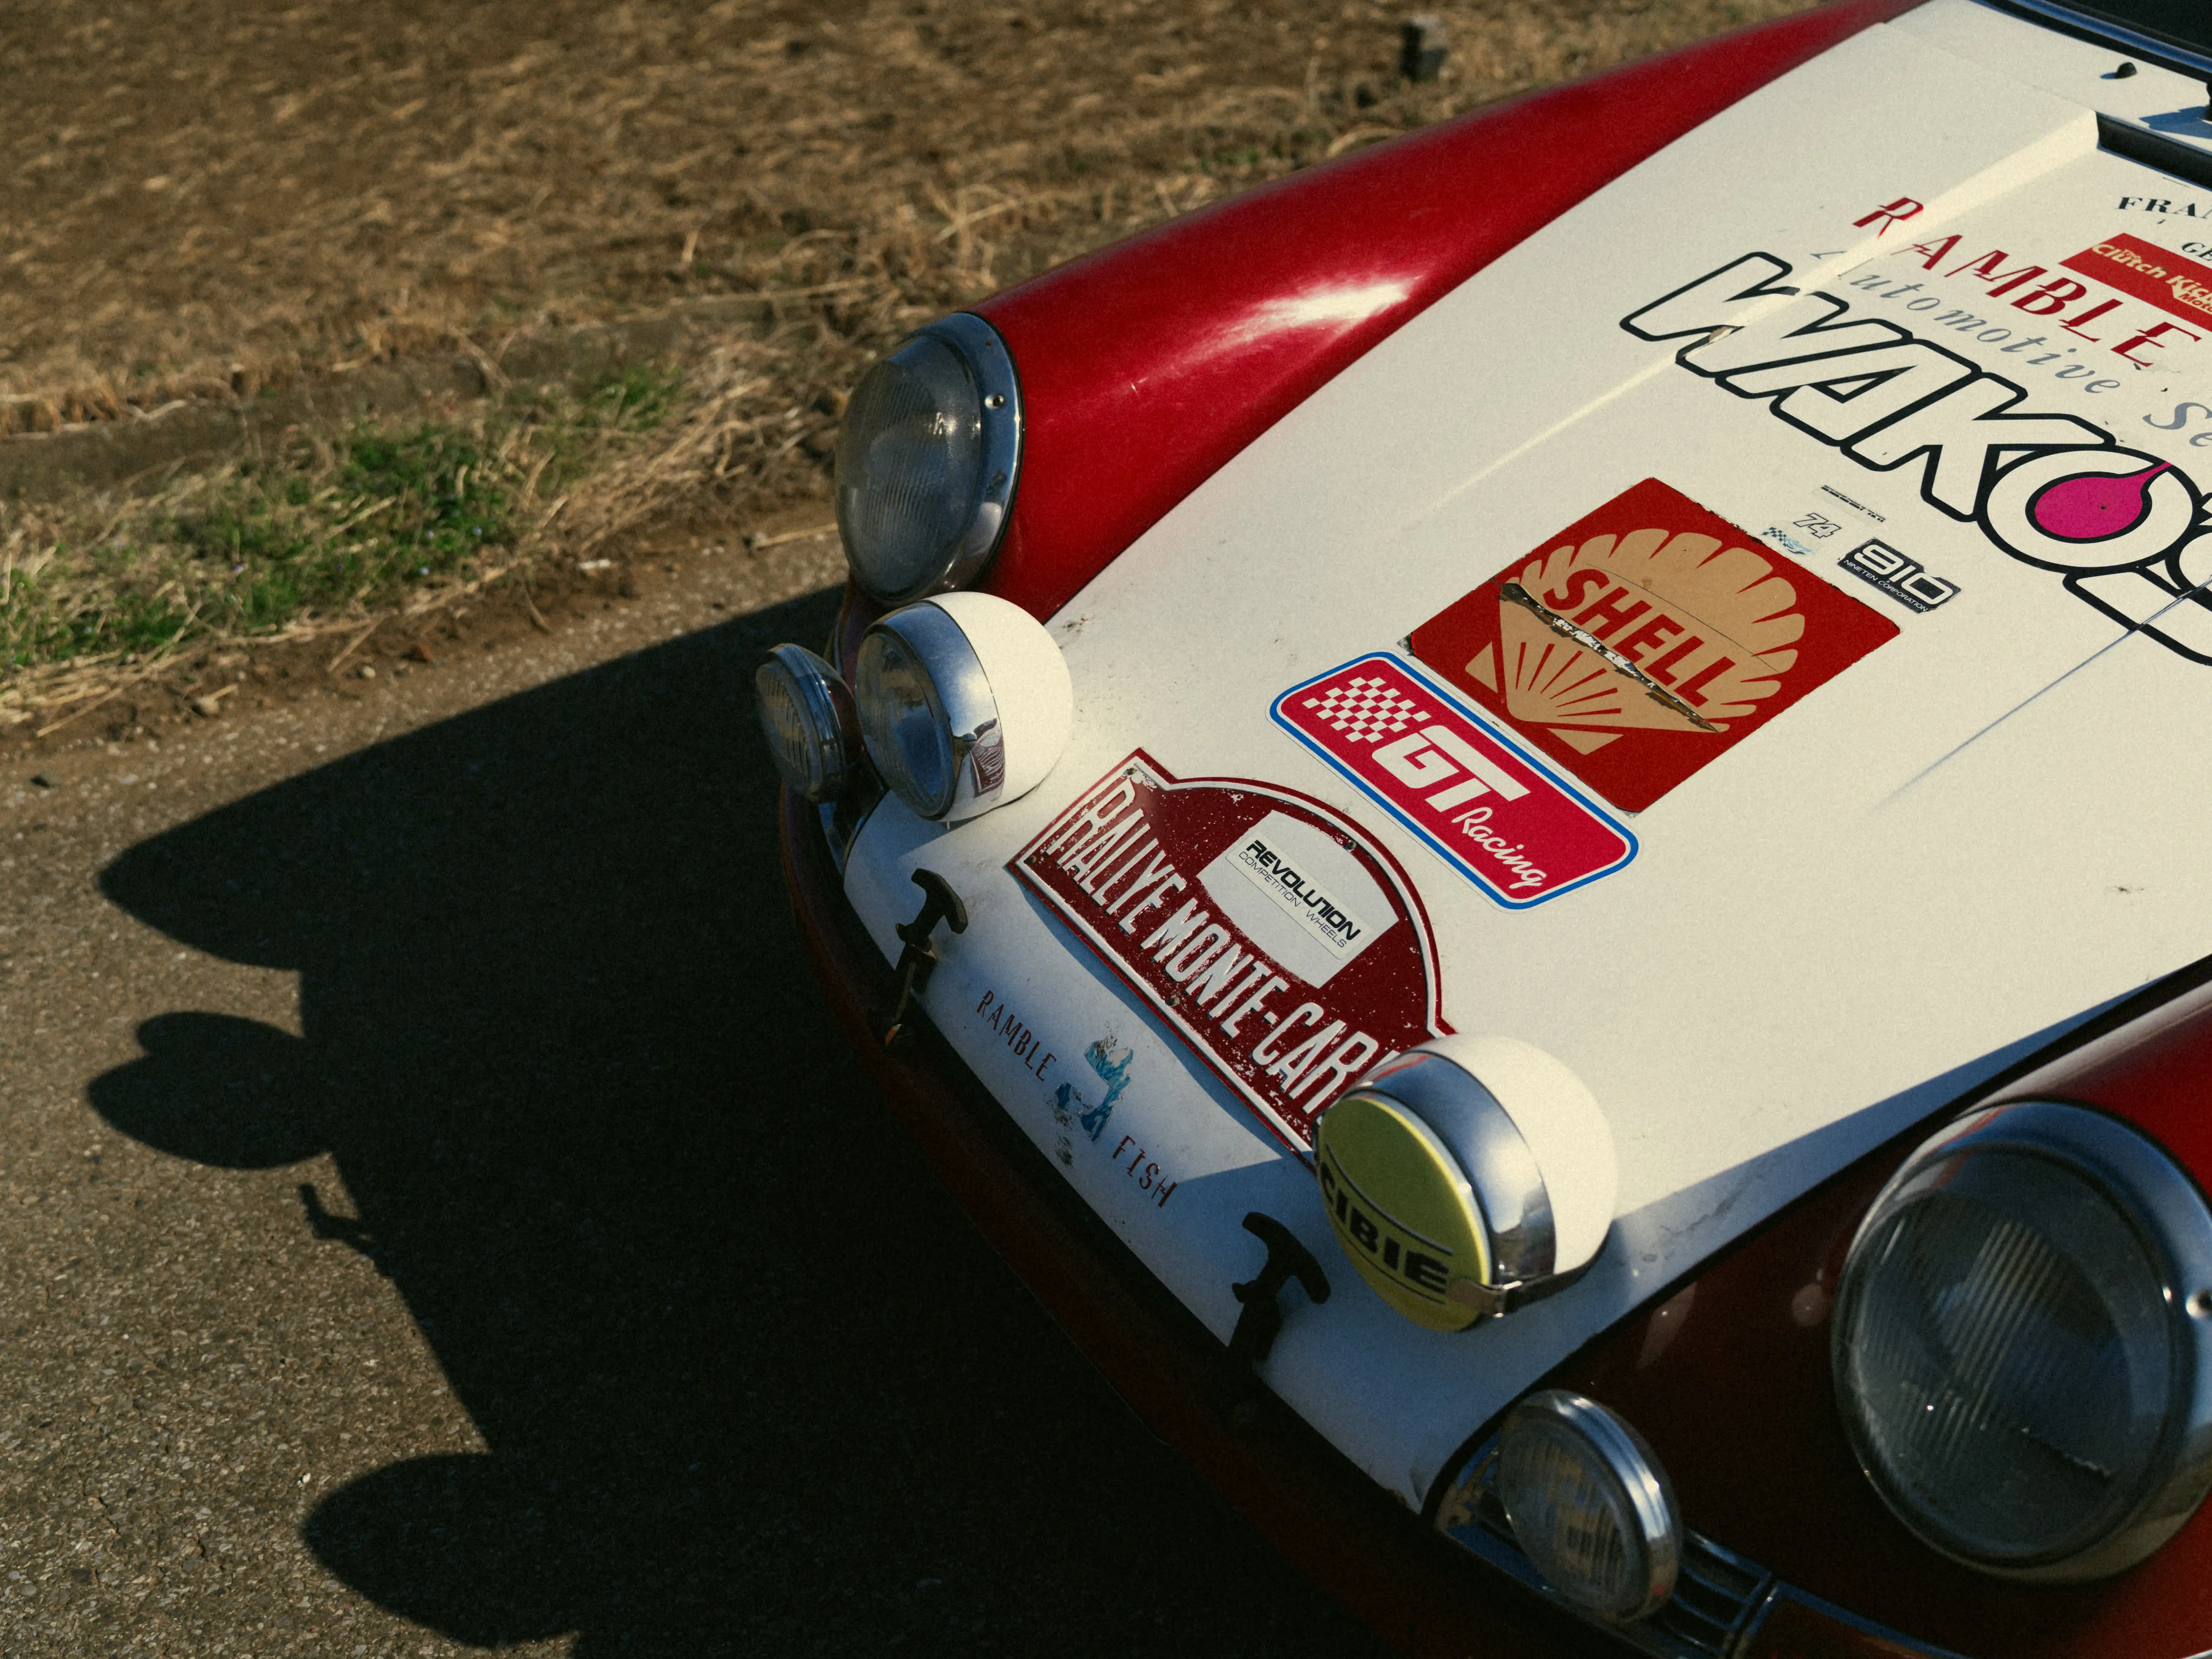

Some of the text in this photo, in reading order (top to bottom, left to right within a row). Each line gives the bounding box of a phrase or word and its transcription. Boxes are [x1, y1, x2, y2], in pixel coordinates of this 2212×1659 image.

[1853, 197, 2202, 367] RAMBLE
[2092, 244, 2167, 279] Clutch
[1792, 512, 1842, 539] 74
[1843, 559, 1929, 612] NINETEN CORPORATION
[1544, 568, 1742, 709] SHELL
[1372, 725, 1531, 812] GT
[1043, 778, 1187, 936] RALLYE
[1246, 839, 1361, 941] REVOLUTION
[1451, 807, 1547, 889] Racing
[1238, 851, 1347, 948] COMPETITION WHEELS
[976, 990, 1178, 1208] RAMBLE FISH
[1319, 1161, 1450, 1296] CIBIE
